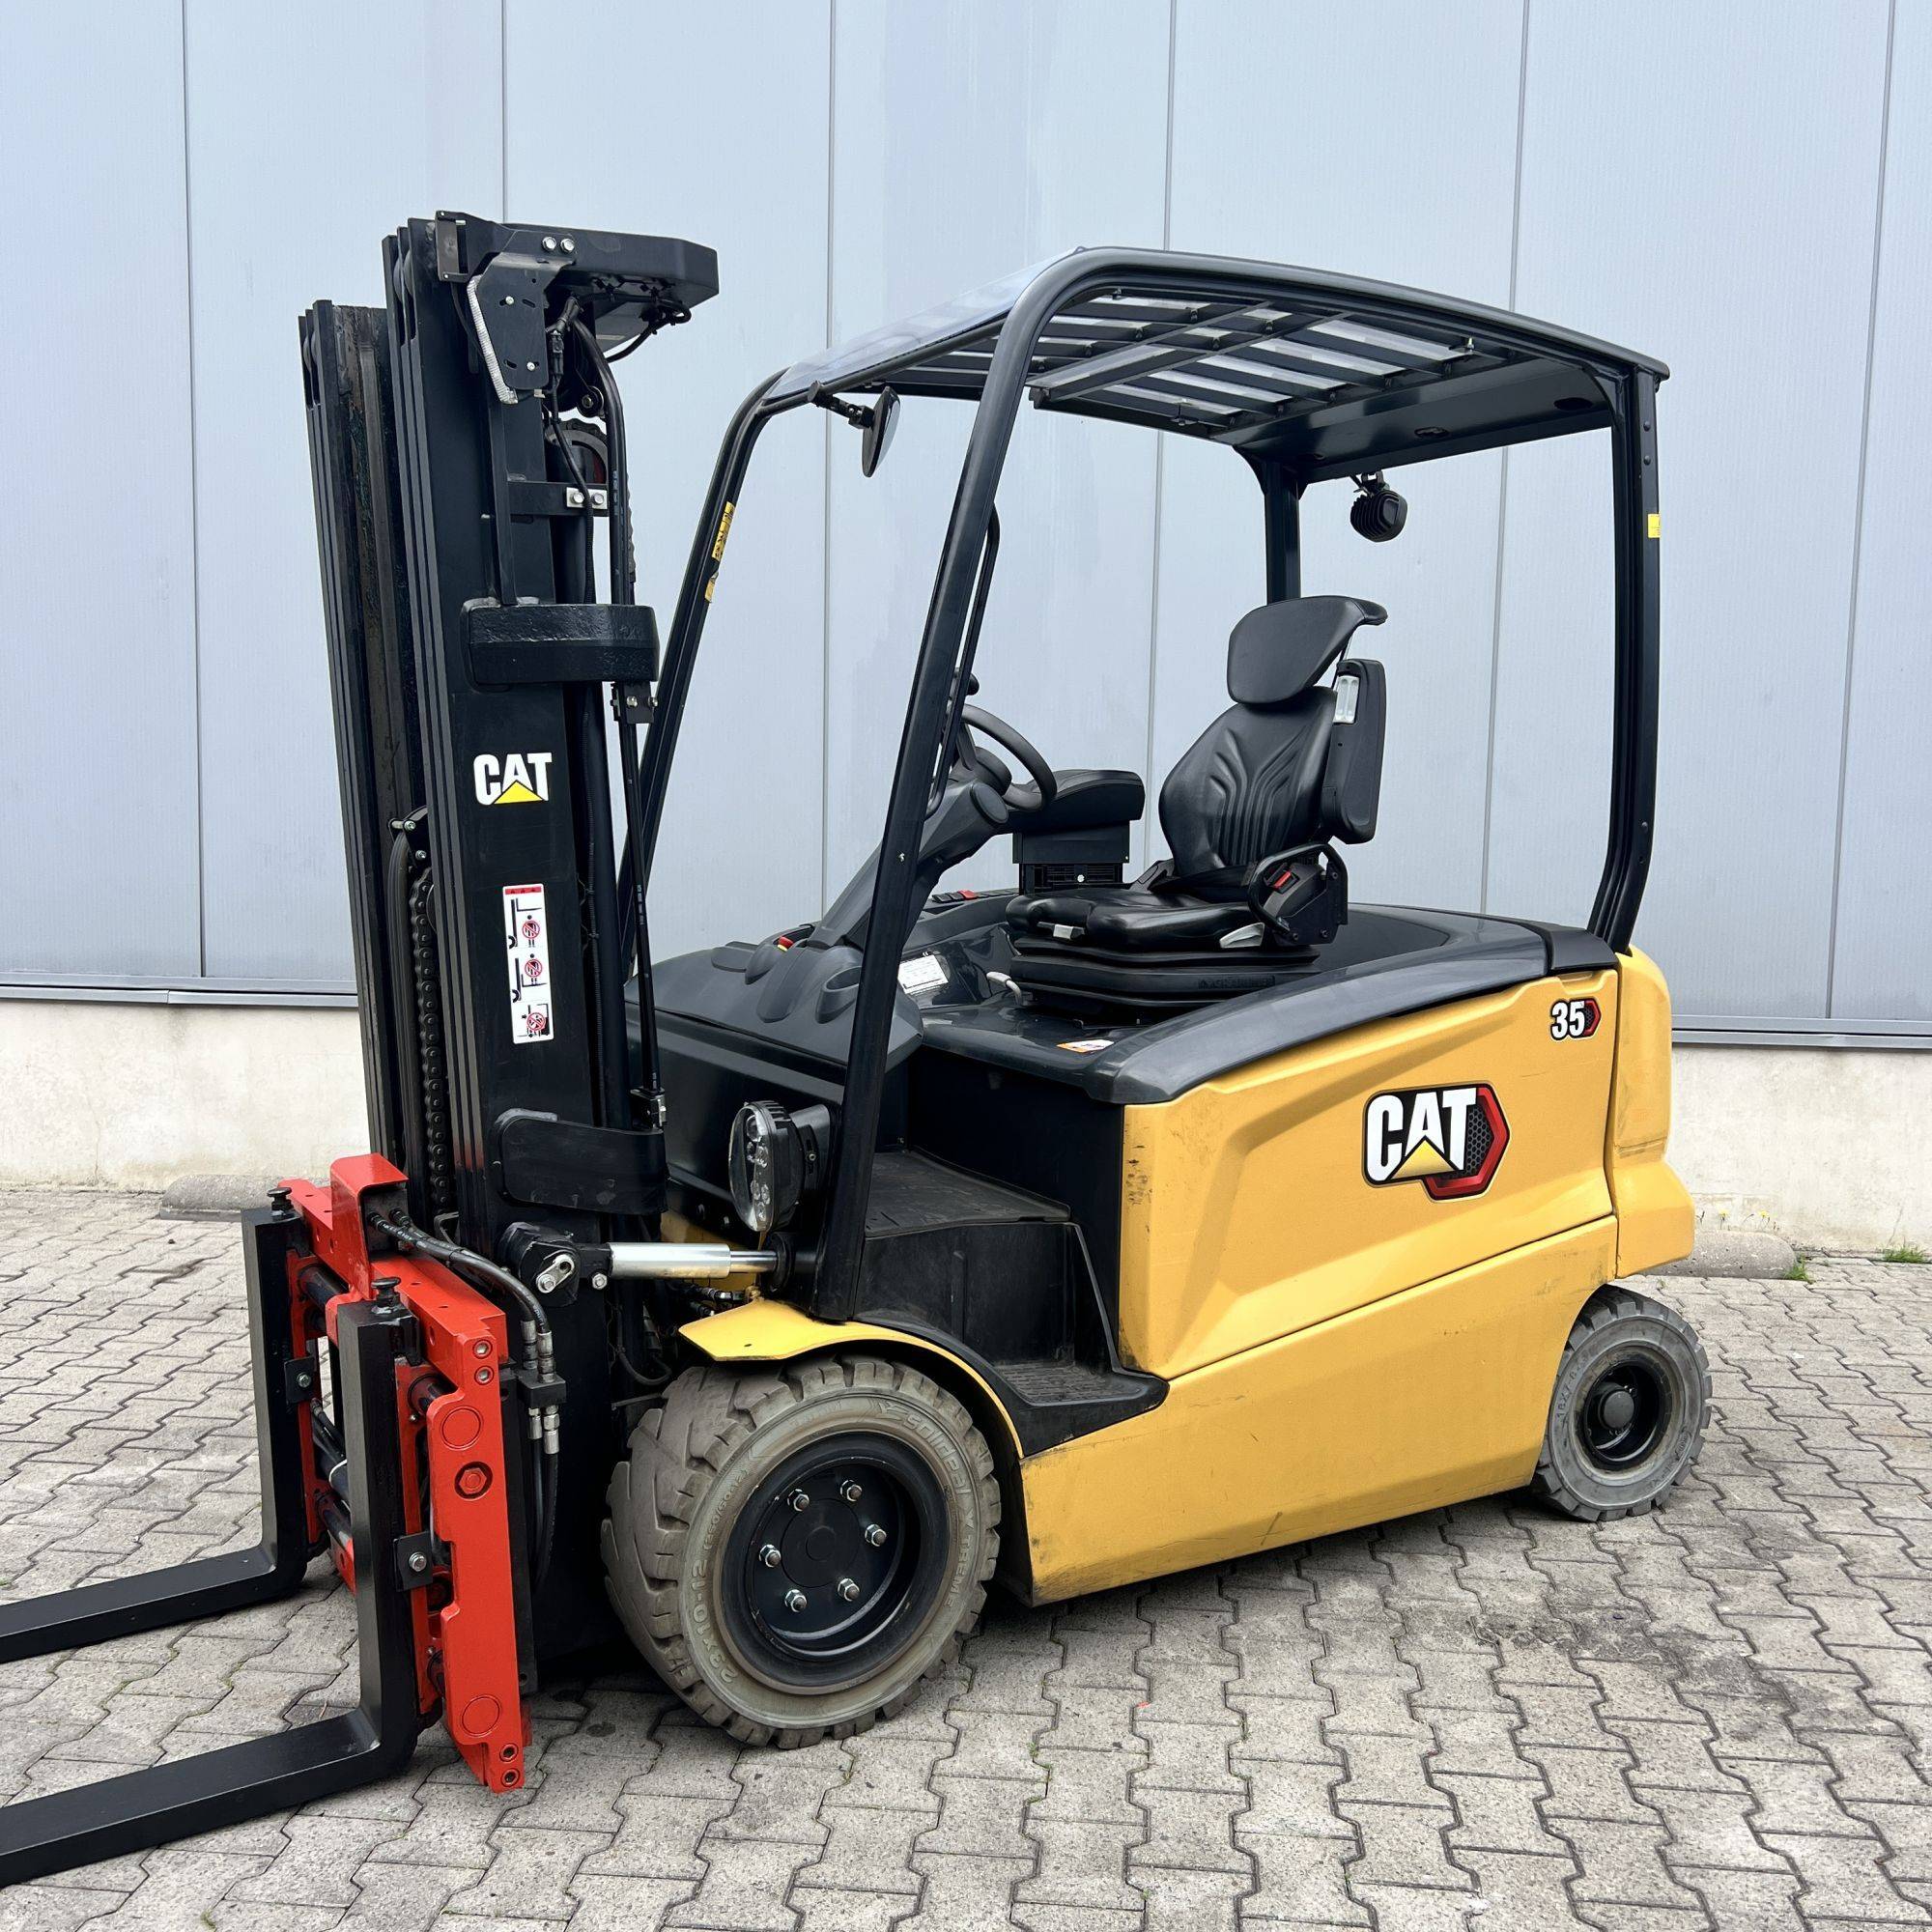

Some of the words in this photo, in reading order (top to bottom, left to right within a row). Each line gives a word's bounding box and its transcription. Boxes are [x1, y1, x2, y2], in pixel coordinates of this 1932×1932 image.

[473, 753, 553, 806] CAT
[1551, 1001, 1585, 1038] 35
[1367, 1088, 1477, 1181] CAT
